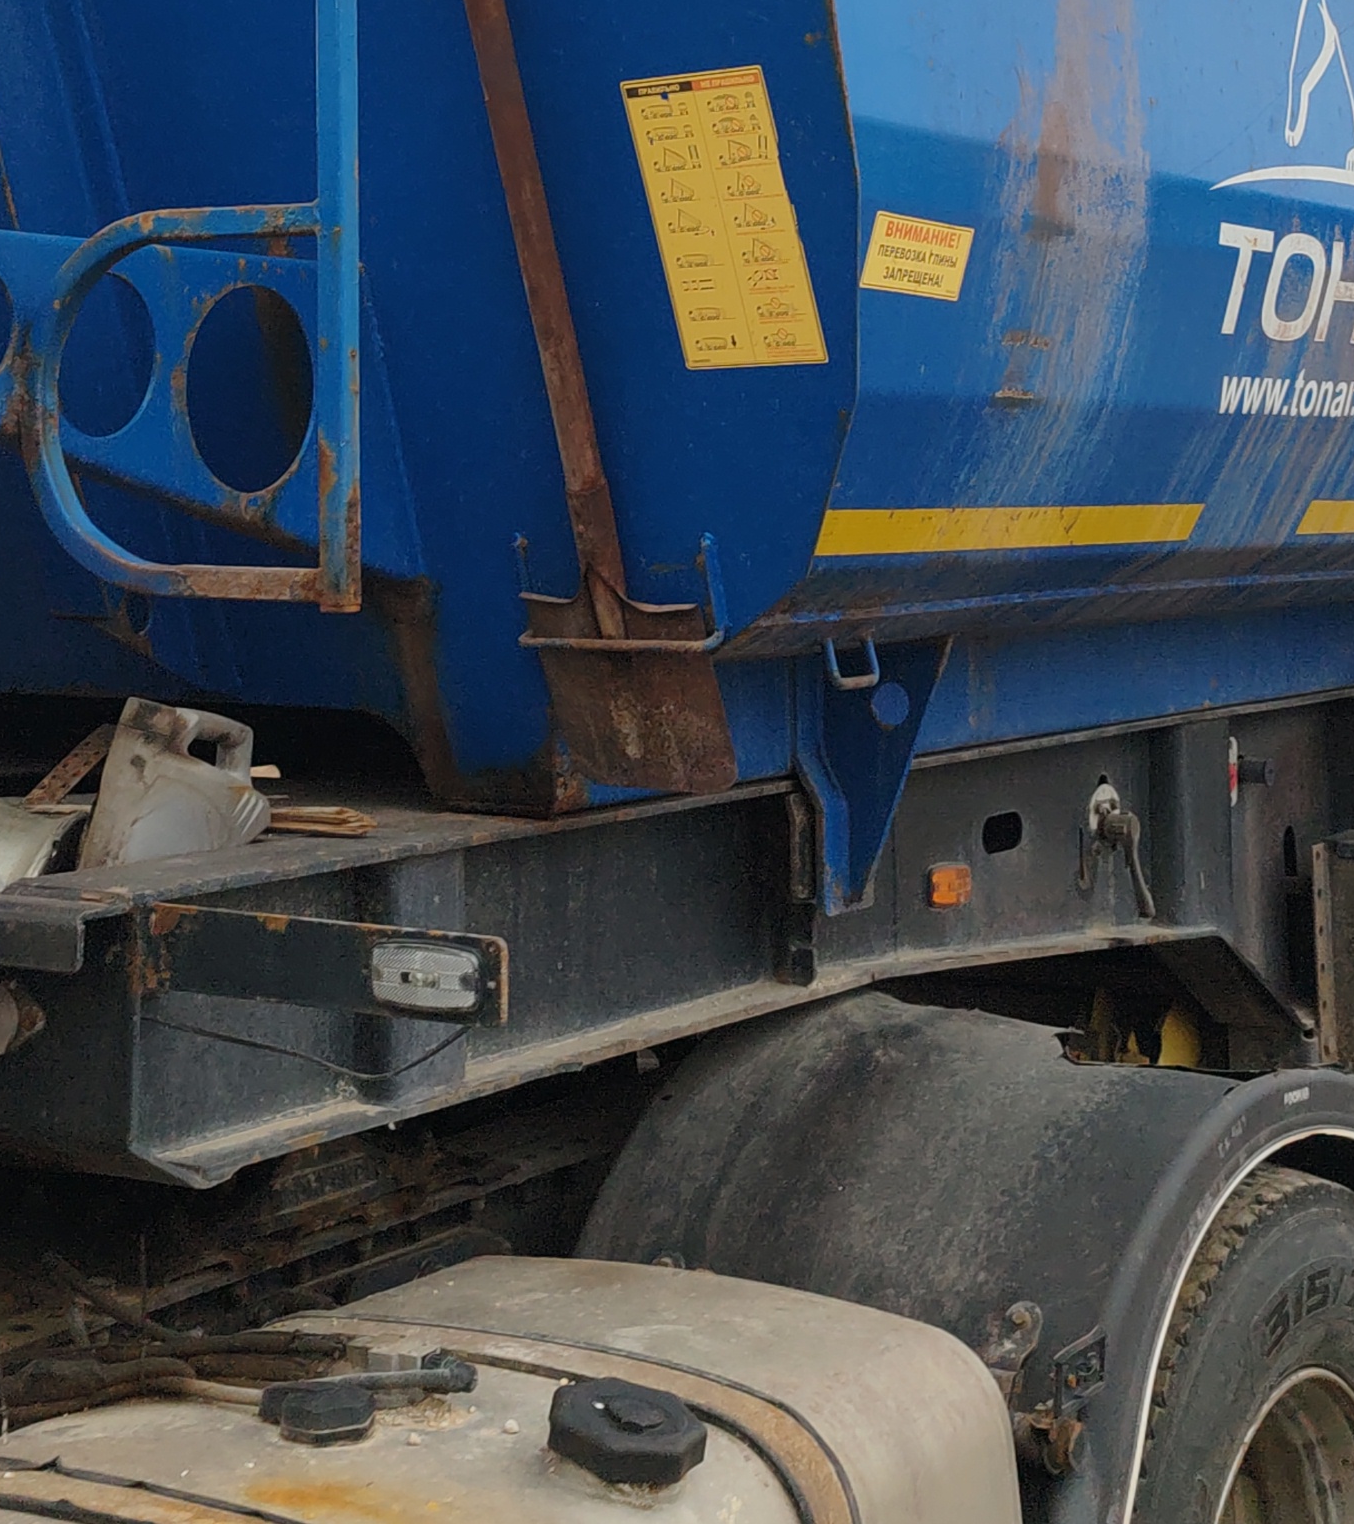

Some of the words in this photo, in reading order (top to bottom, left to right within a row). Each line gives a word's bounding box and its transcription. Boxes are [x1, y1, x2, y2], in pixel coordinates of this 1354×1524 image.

[885, 220, 962, 250] ВНИМАНИЕ!
[877, 243, 927, 264] ПЕРЕВОЗКА
[882, 266, 945, 288] ЗАПРЕЩЕНА!
